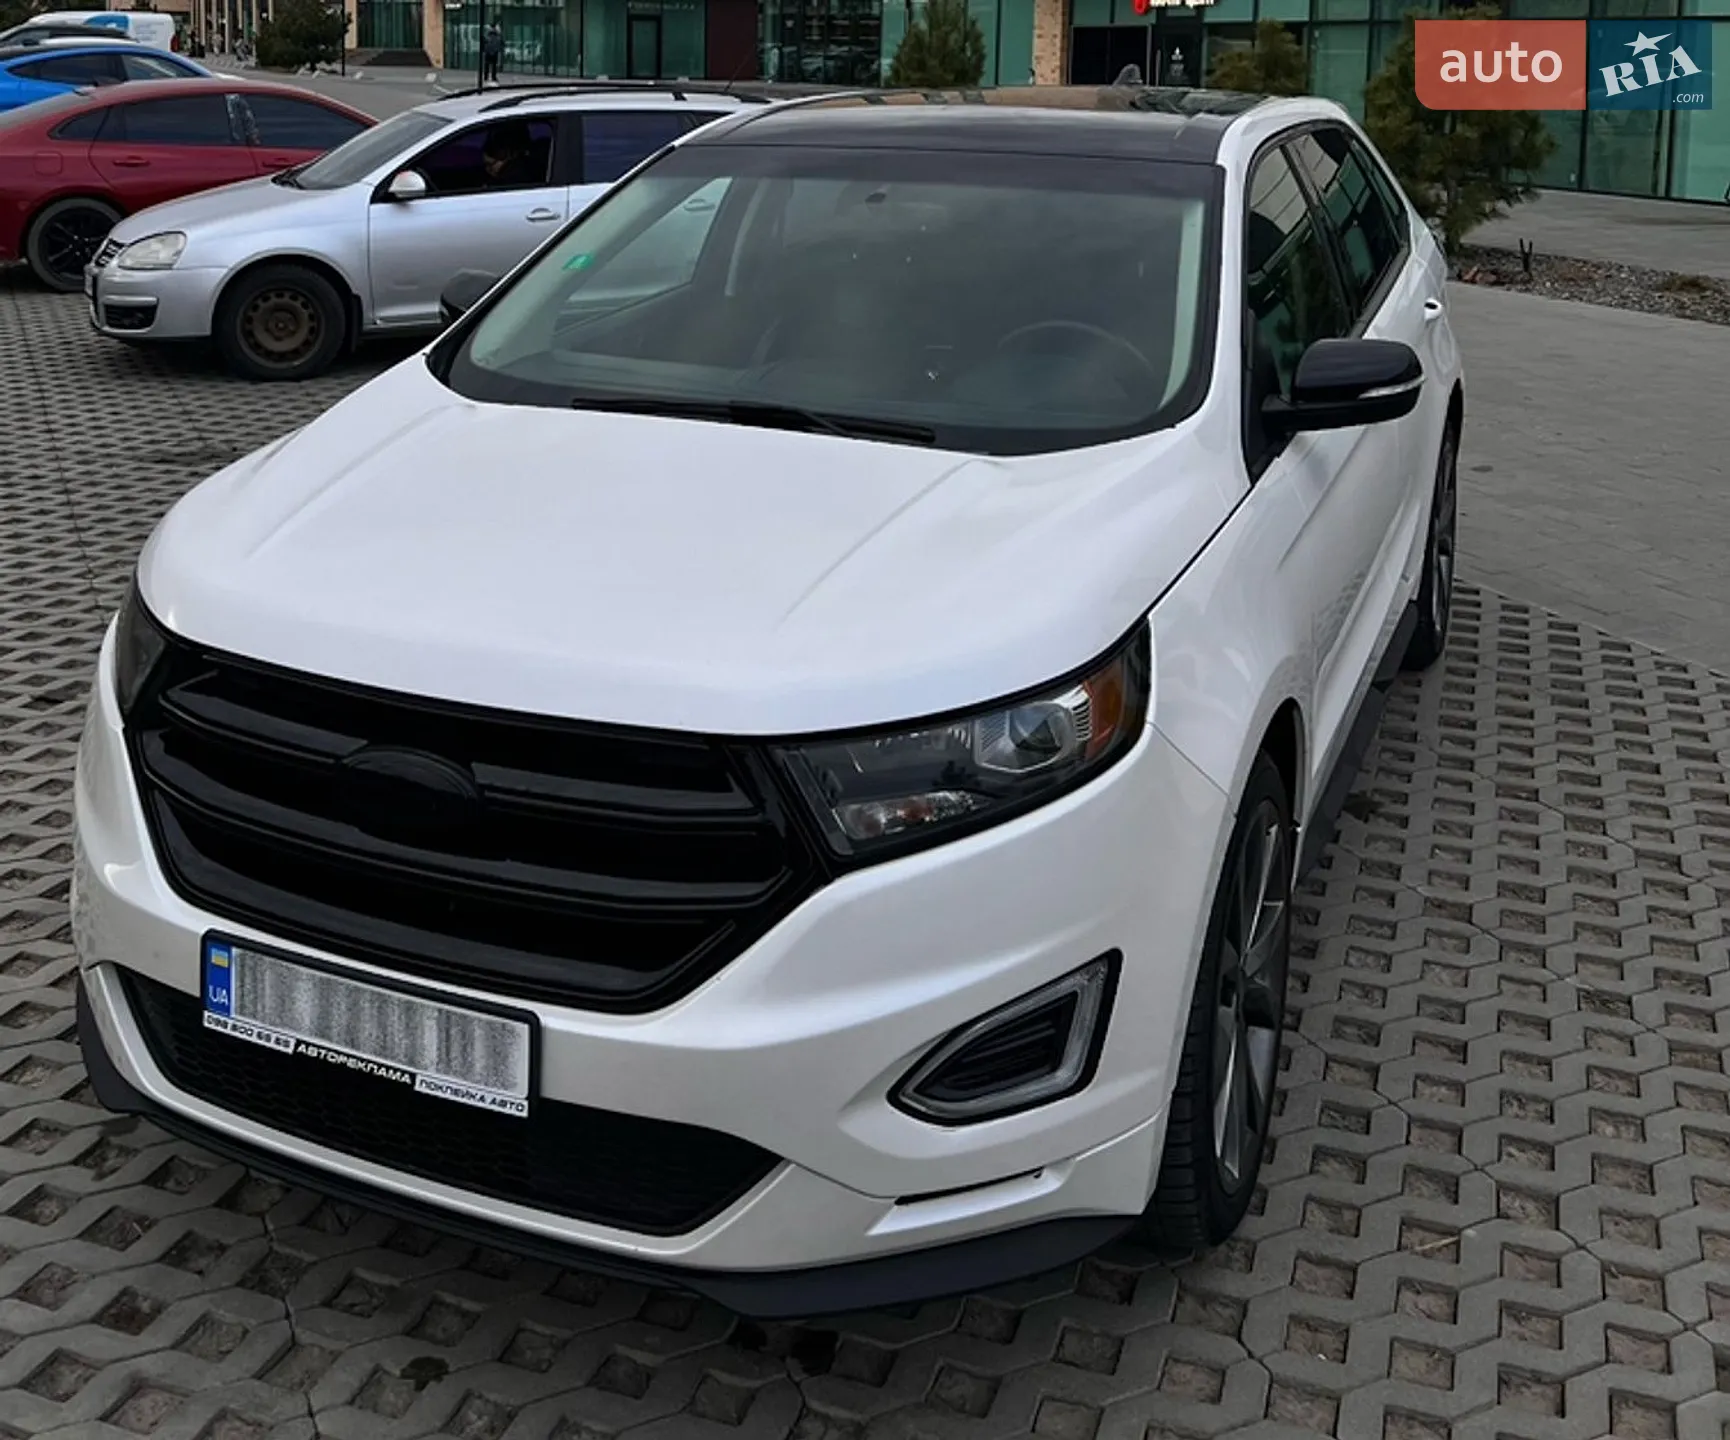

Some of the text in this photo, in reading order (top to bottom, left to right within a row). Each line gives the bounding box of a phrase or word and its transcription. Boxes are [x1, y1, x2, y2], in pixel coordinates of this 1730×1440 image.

[208, 984, 229, 1006] UA
[296, 1043, 412, 1085] АВТОРЕКЛАМА
[488, 1096, 526, 1113] АВТО
